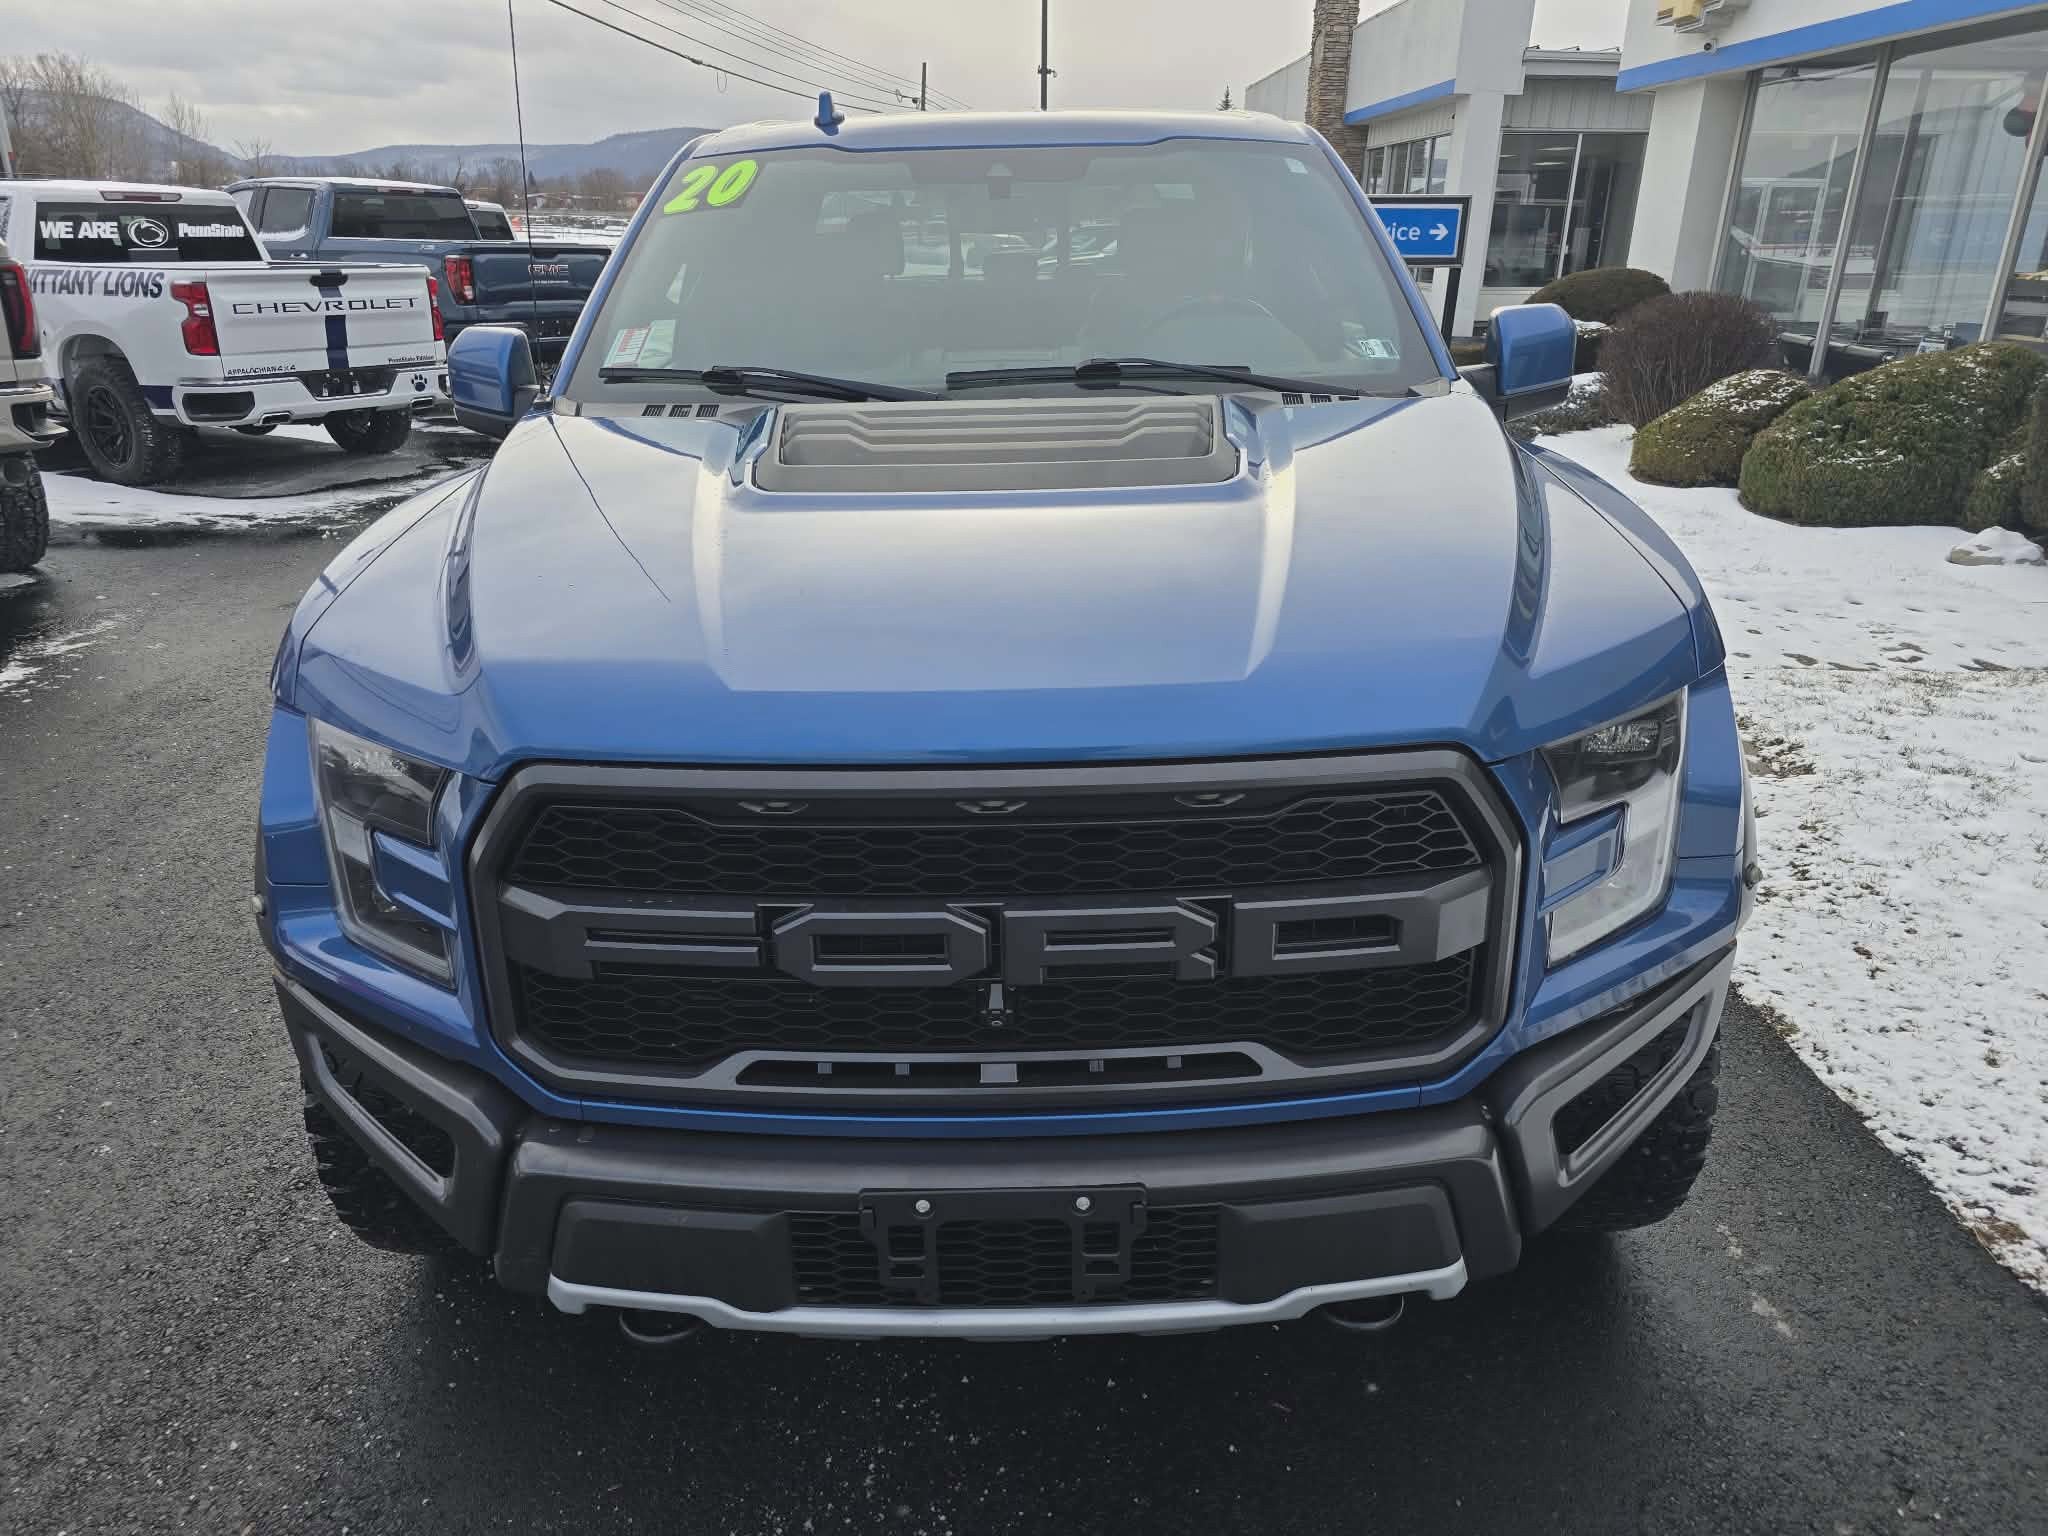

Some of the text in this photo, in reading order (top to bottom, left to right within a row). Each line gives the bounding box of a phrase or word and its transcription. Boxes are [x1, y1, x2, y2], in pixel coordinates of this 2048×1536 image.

[663, 159, 759, 215] 20
[40, 221, 119, 238] WE ARE
[103, 271, 165, 298] LIONS
[232, 298, 418, 315] CHEVROLET
[503, 872, 1493, 987] FORD
